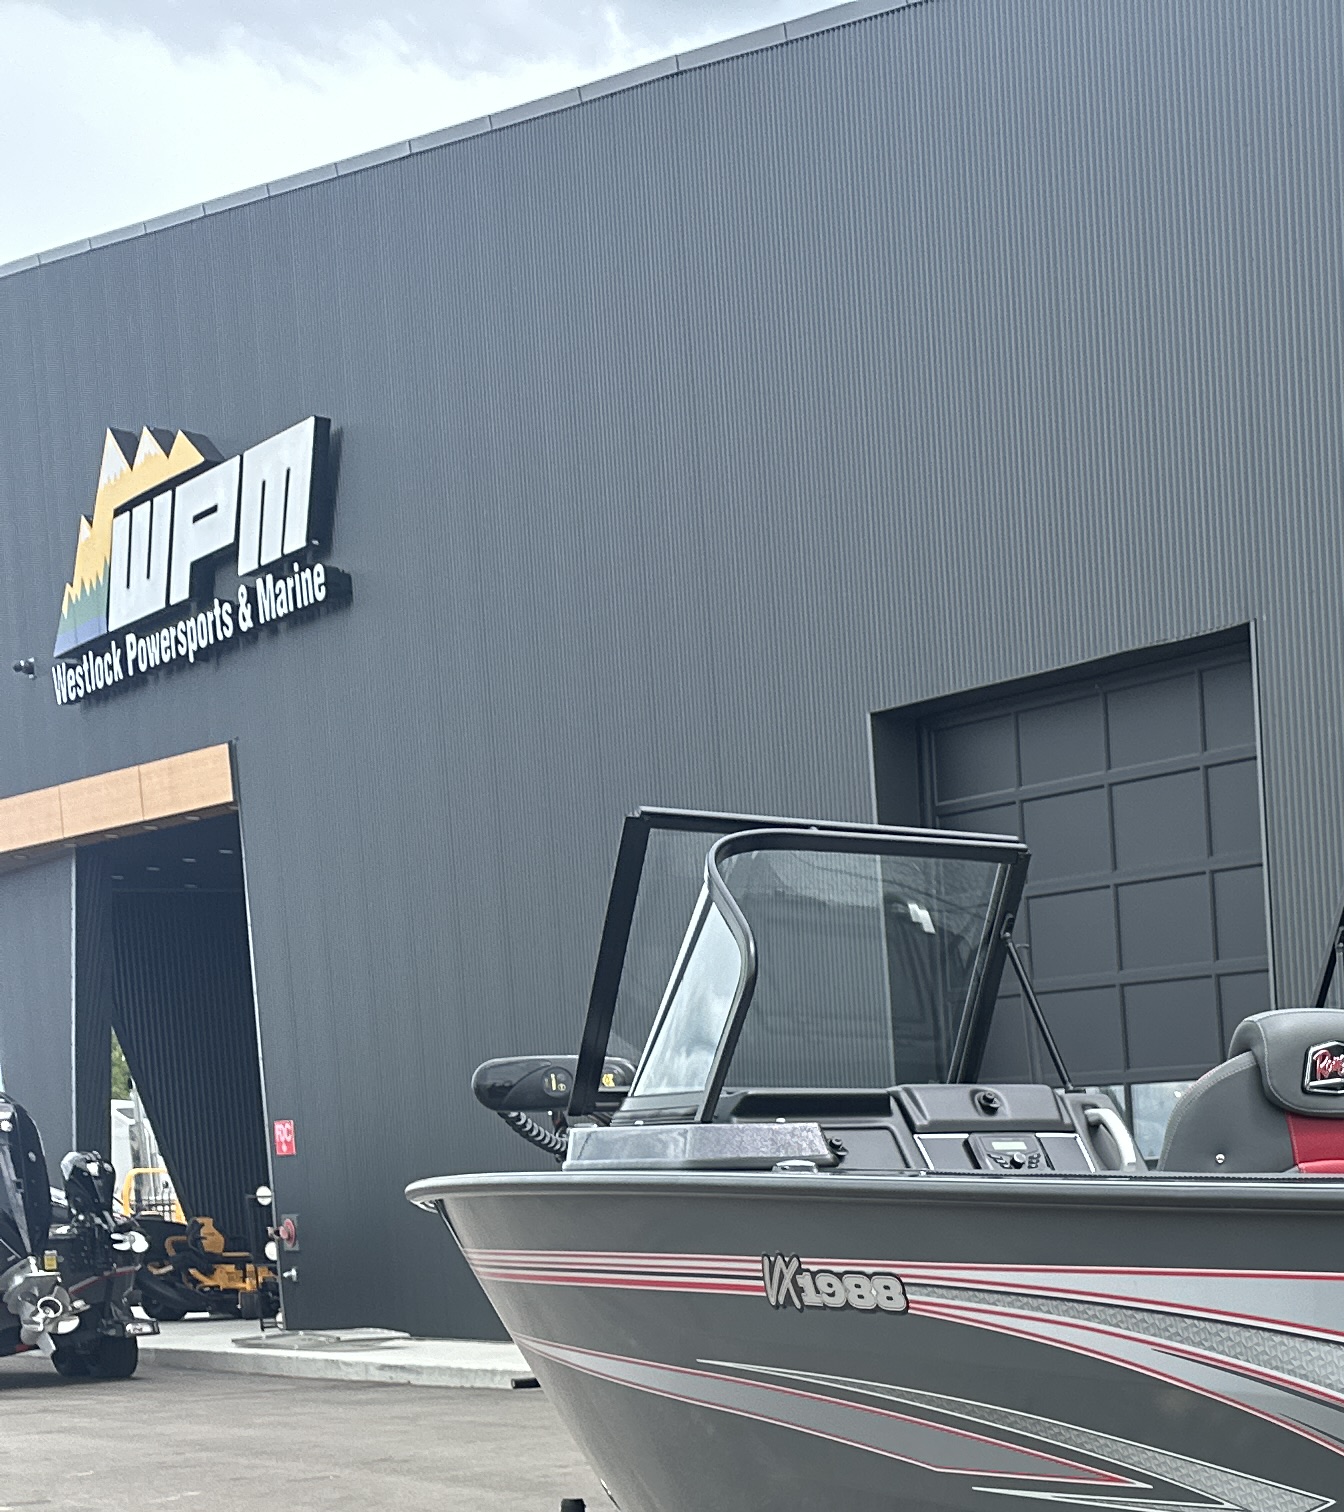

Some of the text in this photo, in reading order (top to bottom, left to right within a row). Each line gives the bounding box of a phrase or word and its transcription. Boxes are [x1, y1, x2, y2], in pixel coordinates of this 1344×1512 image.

[108, 416, 316, 632] WPM
[51, 562, 327, 706] Westlock Powersports & Marine
[274, 1122, 292, 1142] FDC
